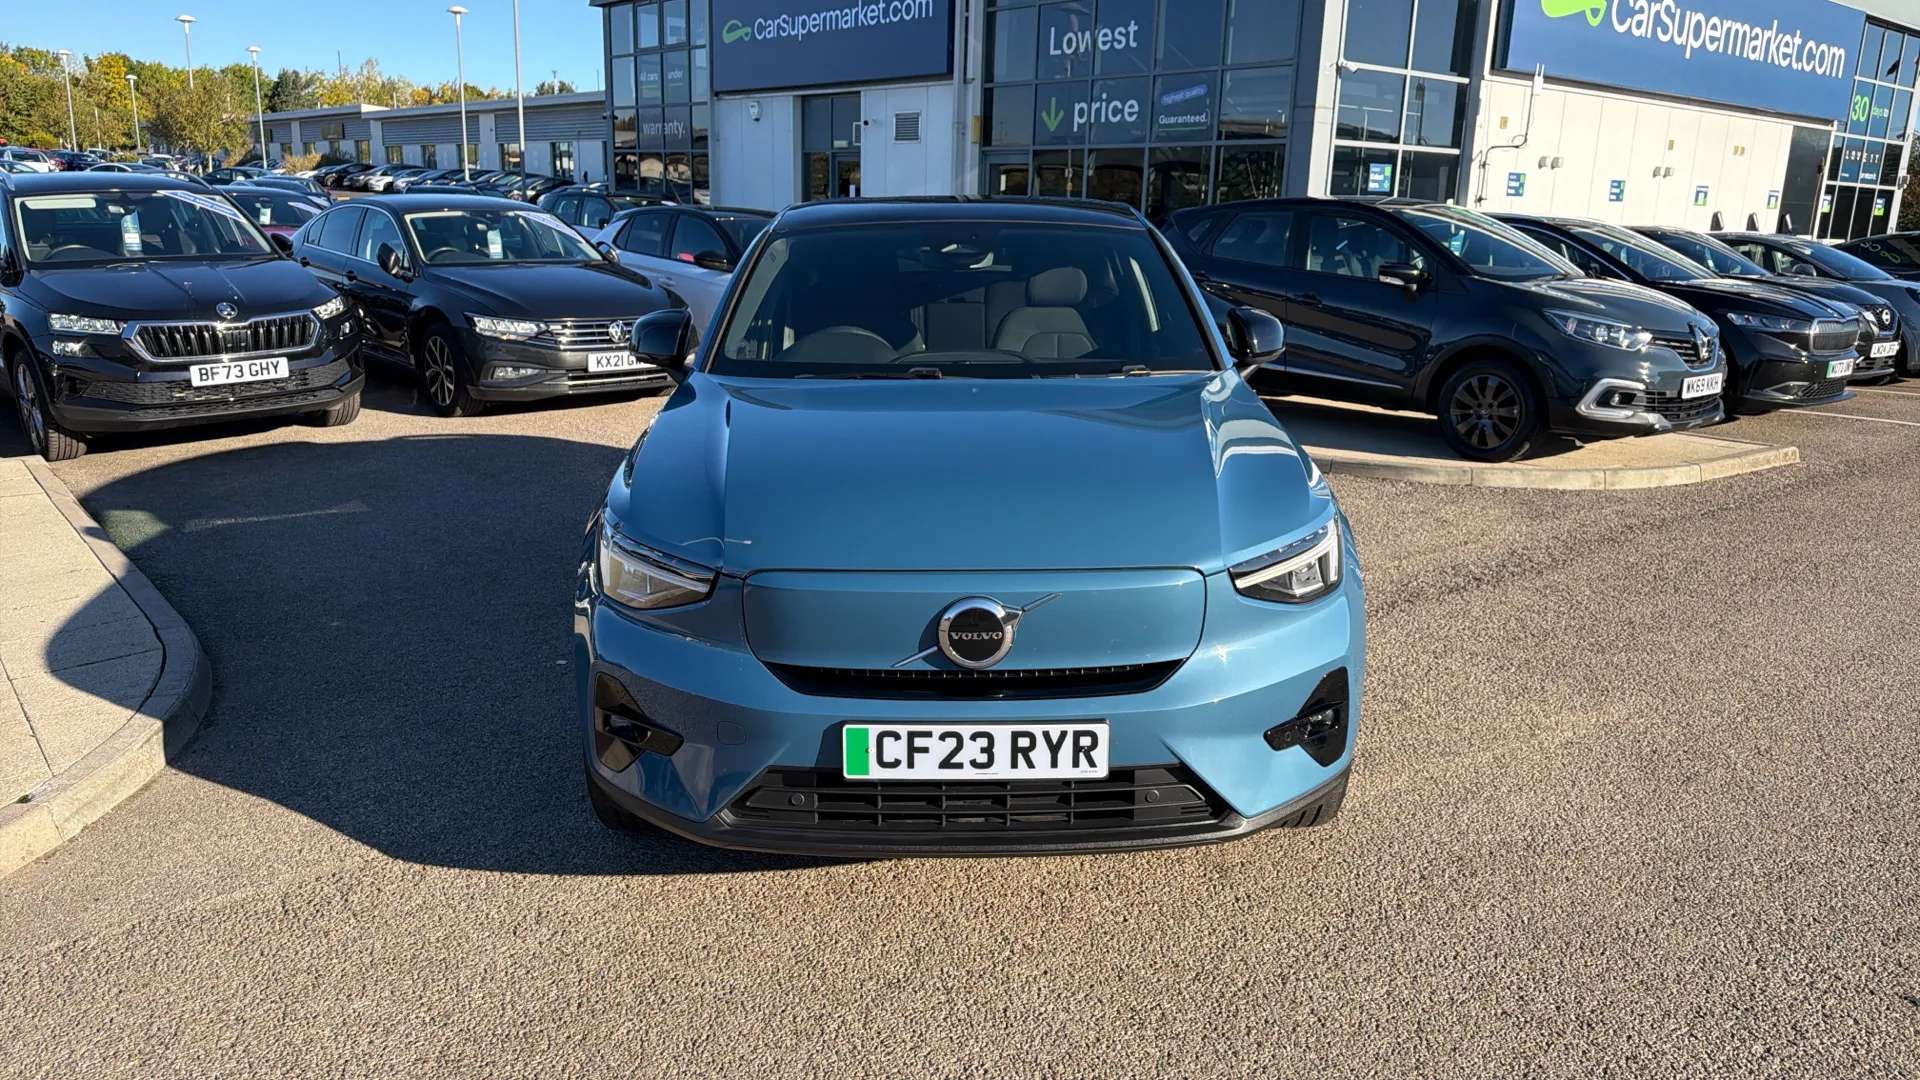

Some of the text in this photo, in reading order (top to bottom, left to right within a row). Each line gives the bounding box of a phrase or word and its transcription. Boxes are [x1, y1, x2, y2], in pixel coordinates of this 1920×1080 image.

[754, 0, 933, 40] CarSupermarket.com
[1050, 20, 1139, 56] Lowest
[1611, 0, 1846, 79] CarSupermarket.com
[1073, 93, 1139, 132] price
[1159, 112, 1207, 124] Guaranteed.
[1851, 95, 1870, 121] 30
[643, 120, 686, 139] warranty.
[198, 360, 280, 382] BF73 GHY
[596, 355, 624, 369] KX21
[950, 631, 1003, 641] VOLVO
[875, 730, 1100, 770] CF23 RYR
